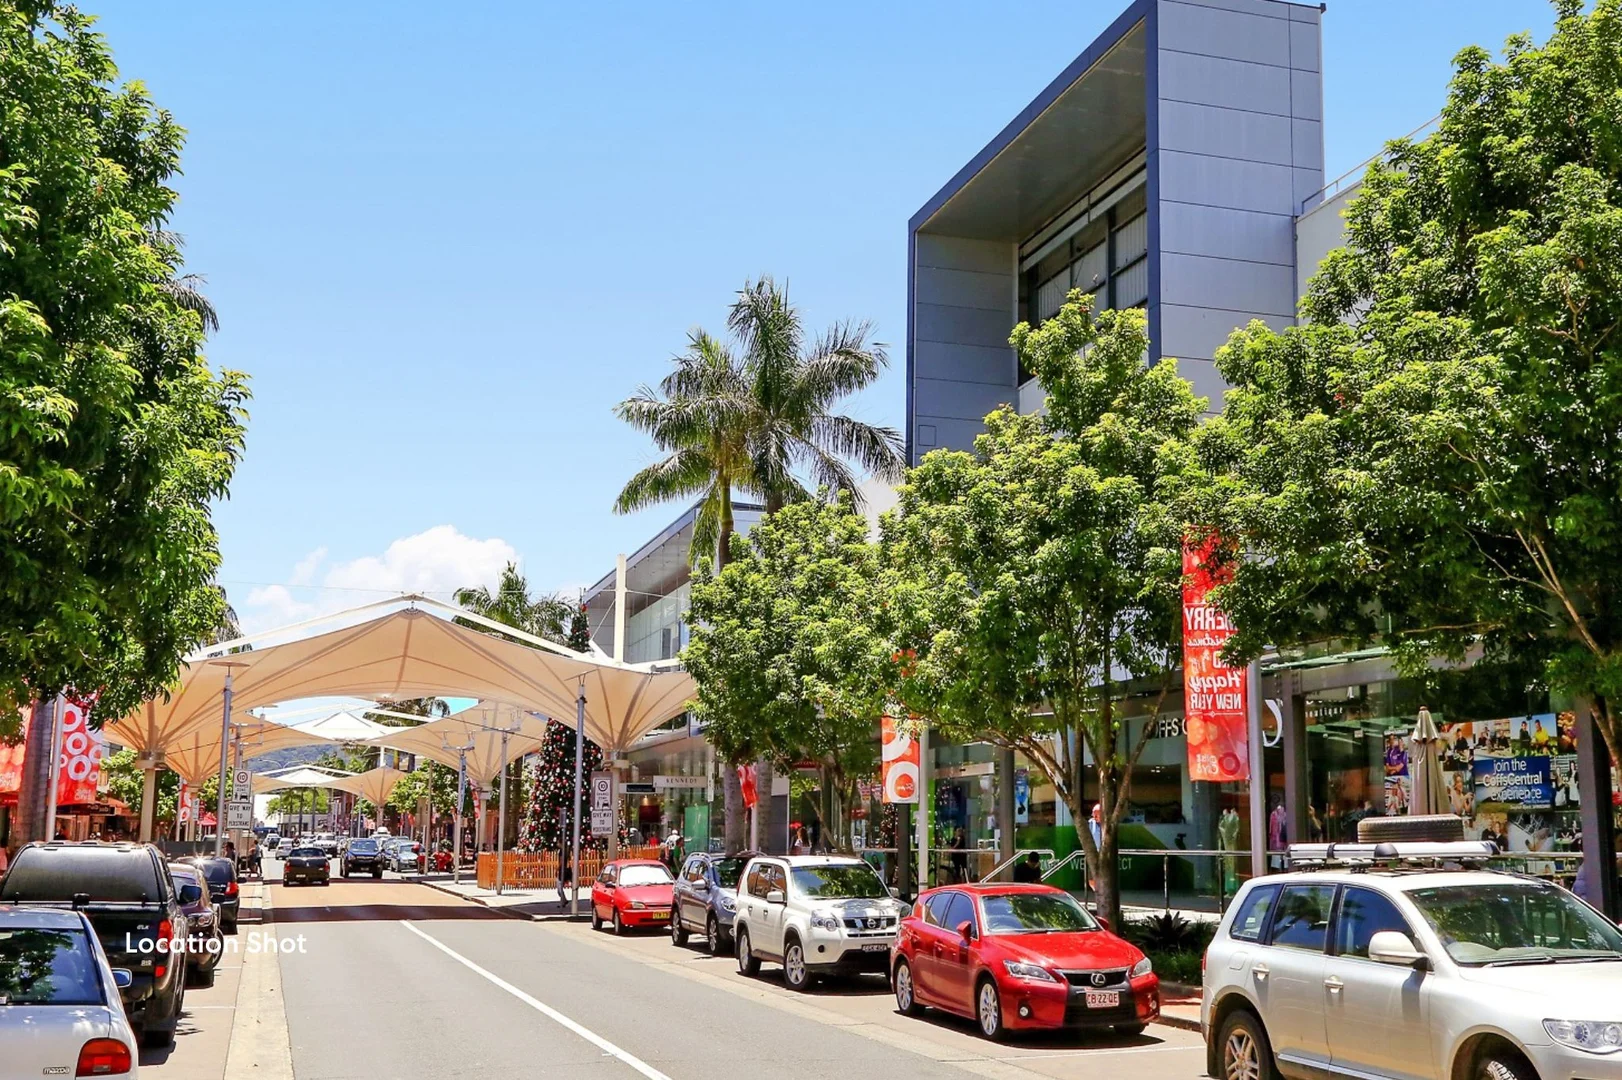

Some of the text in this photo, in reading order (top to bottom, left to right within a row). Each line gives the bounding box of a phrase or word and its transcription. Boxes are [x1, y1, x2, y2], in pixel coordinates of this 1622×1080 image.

[1493, 759, 1527, 774] join the
[1483, 771, 1542, 786] CoffsCentral
[1491, 787, 1541, 803] experience
